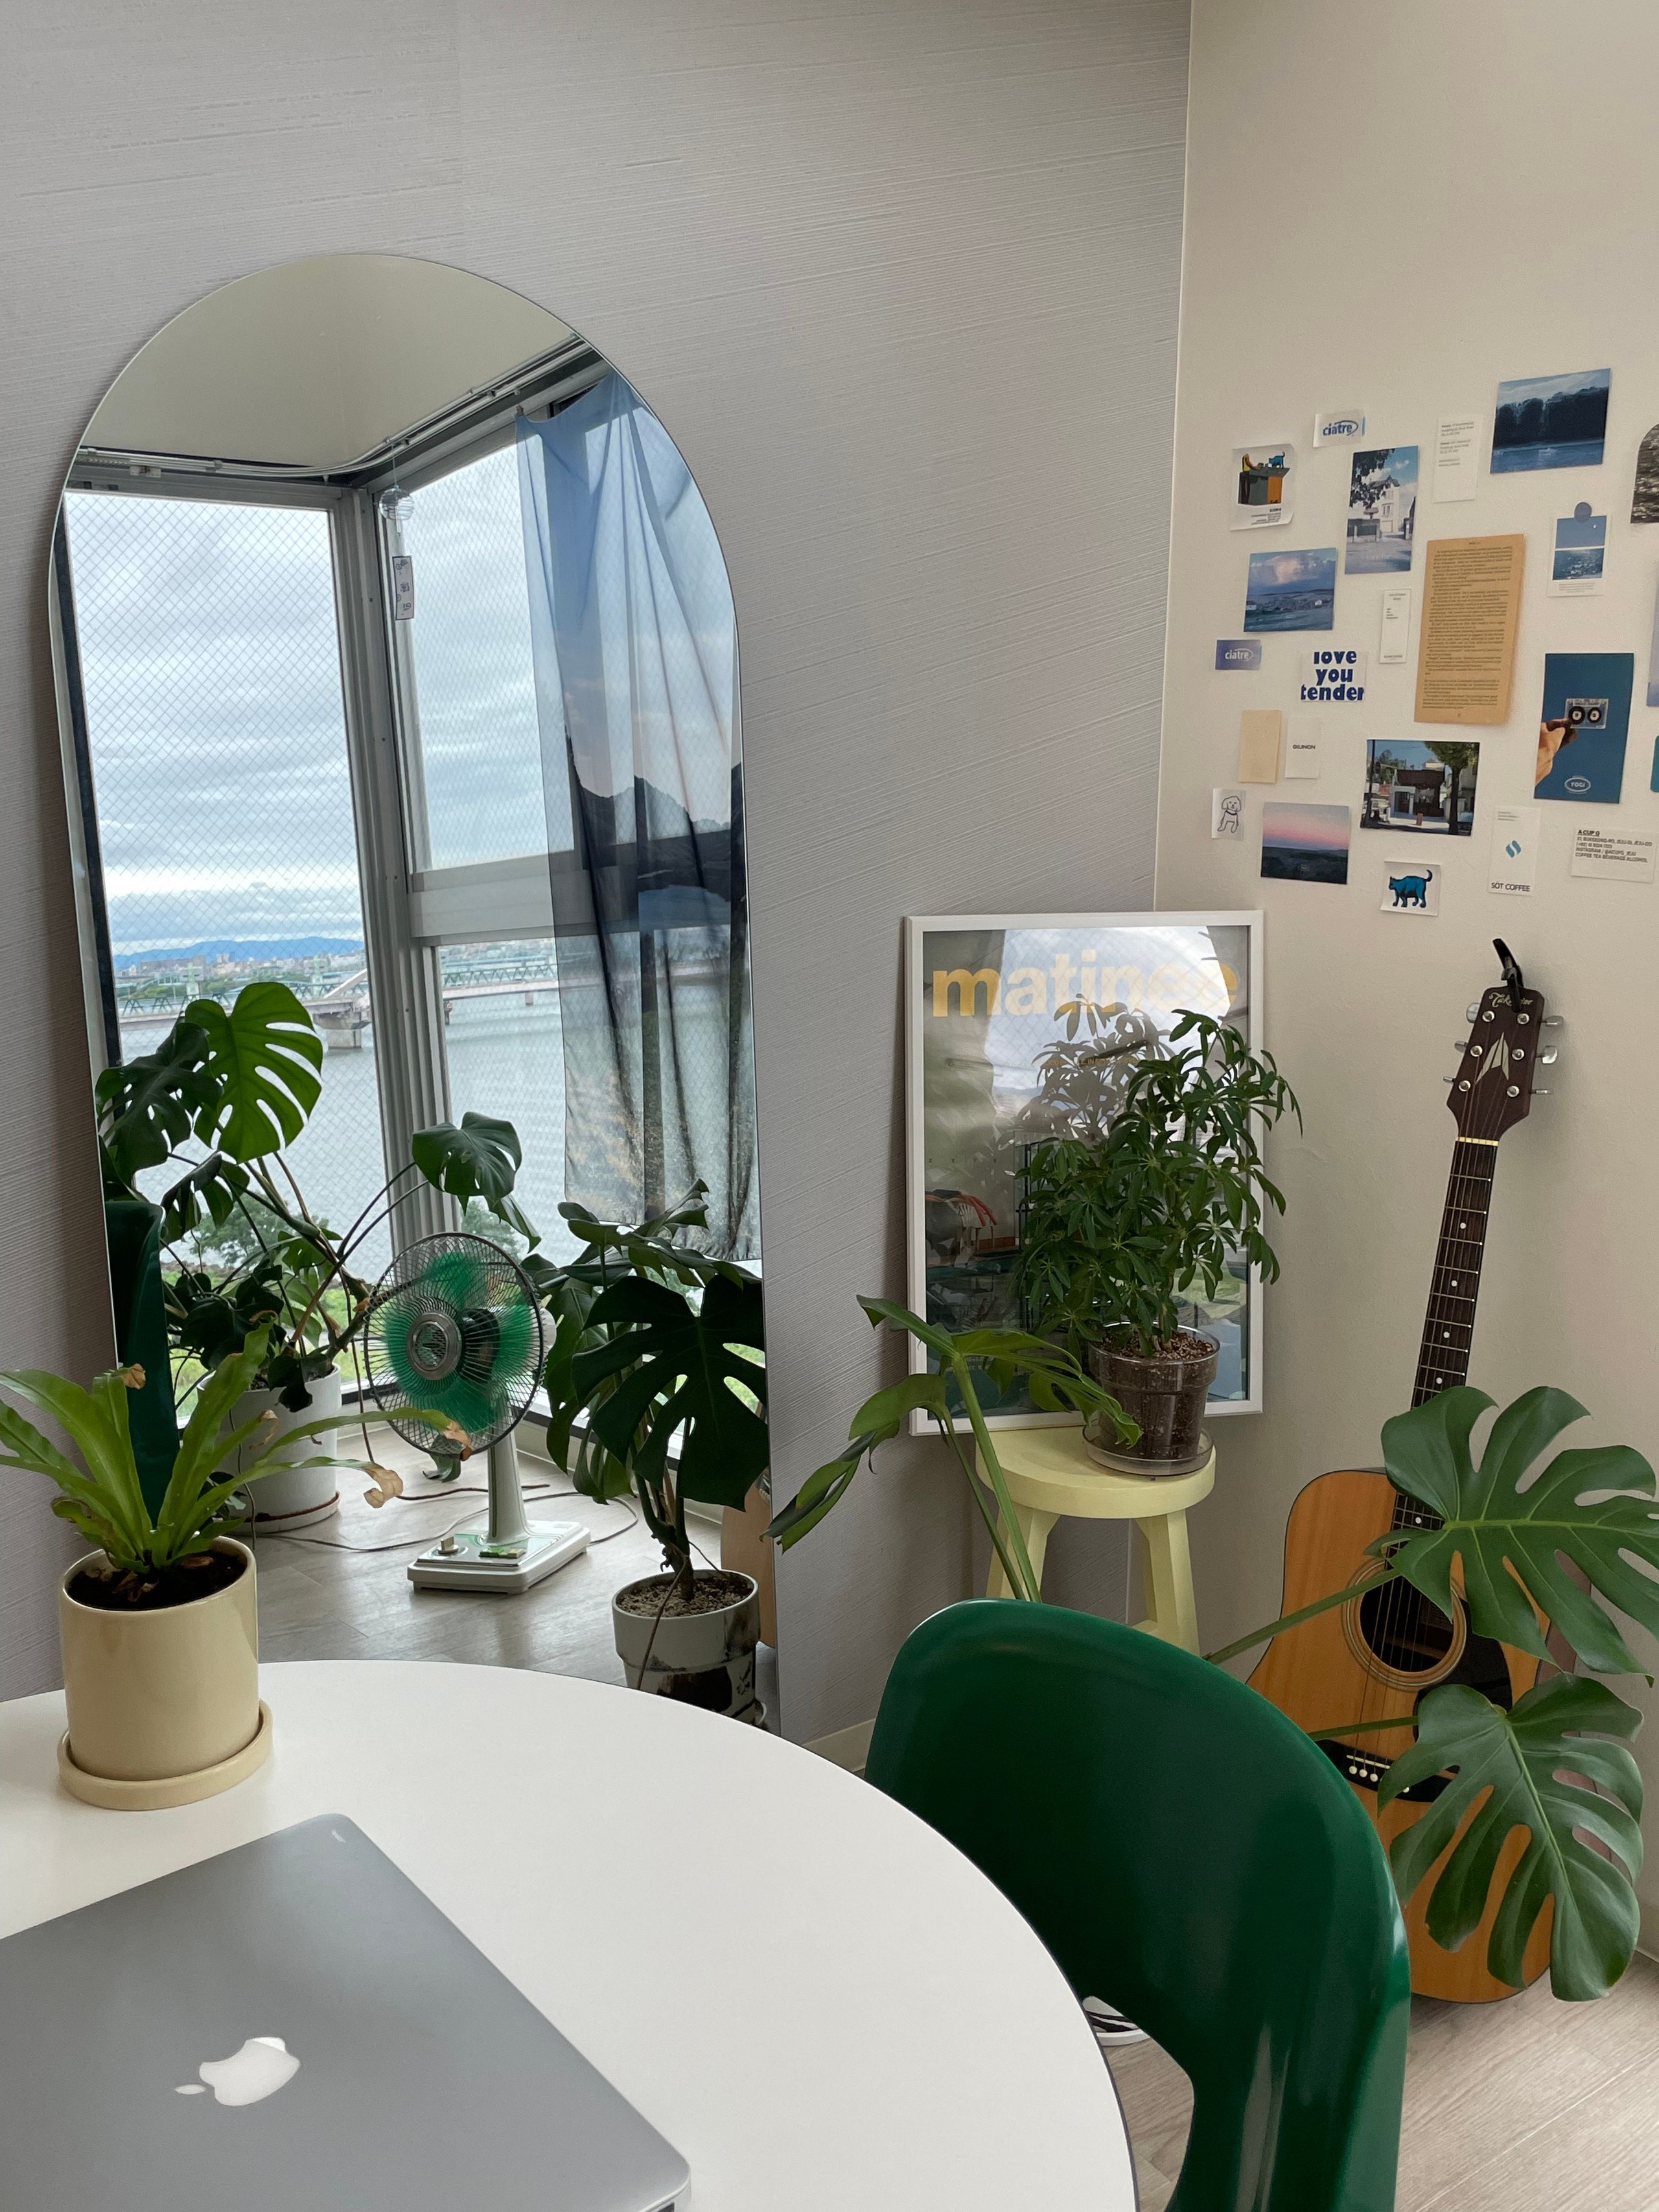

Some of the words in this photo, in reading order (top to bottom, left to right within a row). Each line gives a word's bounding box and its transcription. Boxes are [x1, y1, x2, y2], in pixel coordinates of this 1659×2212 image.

[1323, 422, 1354, 436] ciatre
[1314, 651, 1357, 664] love
[1316, 669, 1353, 686] you
[1301, 684, 1364, 701] tender
[1505, 883, 1531, 892] COFFEE
